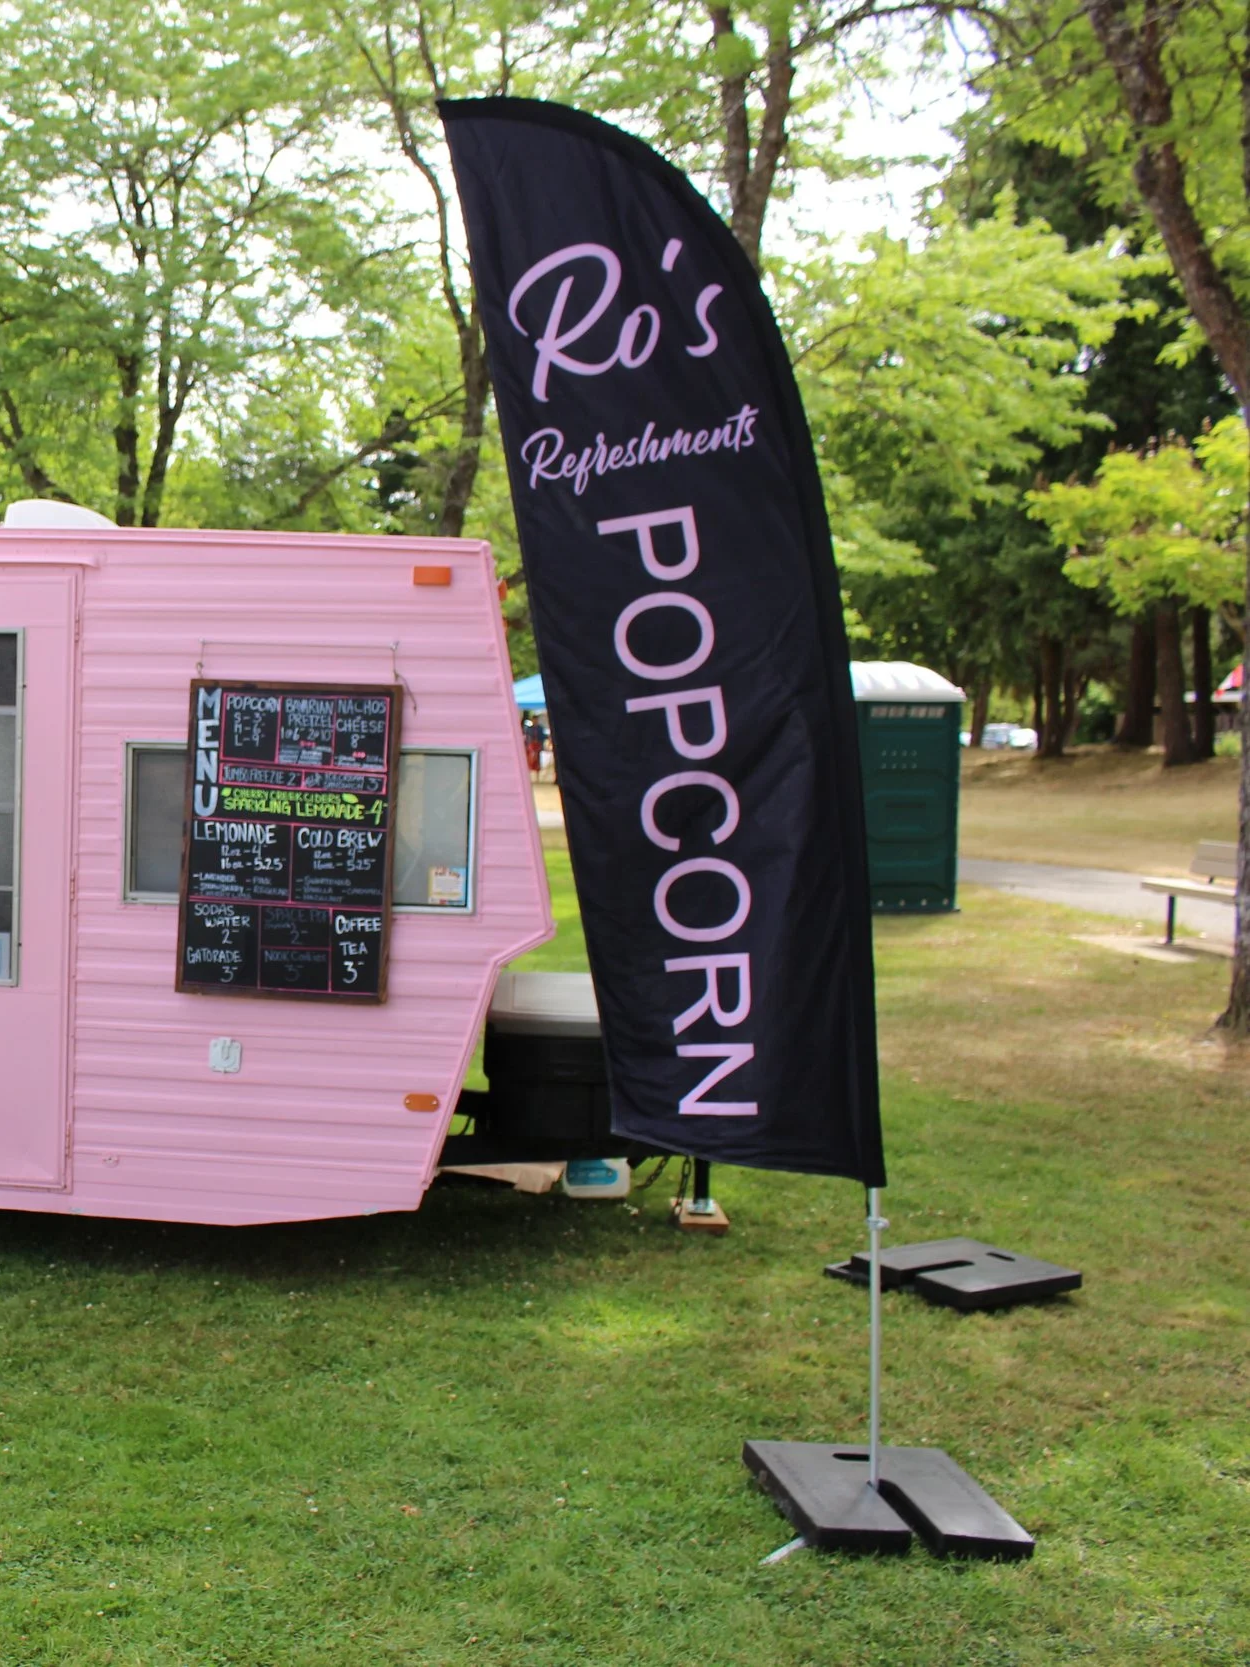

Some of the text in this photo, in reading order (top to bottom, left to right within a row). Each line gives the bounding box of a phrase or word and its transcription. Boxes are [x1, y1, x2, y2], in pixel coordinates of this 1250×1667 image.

[507, 237, 724, 403] Ro's
[520, 404, 760, 497] Refreshments
[226, 695, 280, 712] POPCORN
[285, 698, 334, 714] BAVARIAN
[338, 698, 387, 714] NACHOS
[288, 714, 334, 728] PRETZEL
[336, 717, 386, 733] CHEESE
[195, 687, 223, 817] MENU
[223, 798, 291, 816] SPARKLING
[295, 801, 365, 820] LEMONADE
[596, 504, 760, 1117] POPCORN
[194, 820, 277, 844] LEMONADE
[297, 827, 383, 849] COLD BREW
[194, 903, 235, 916] SODAS
[205, 915, 251, 928] WATER
[335, 914, 382, 935] COFFEE
[186, 946, 243, 964] GATORADE
[339, 941, 369, 956] TEA
